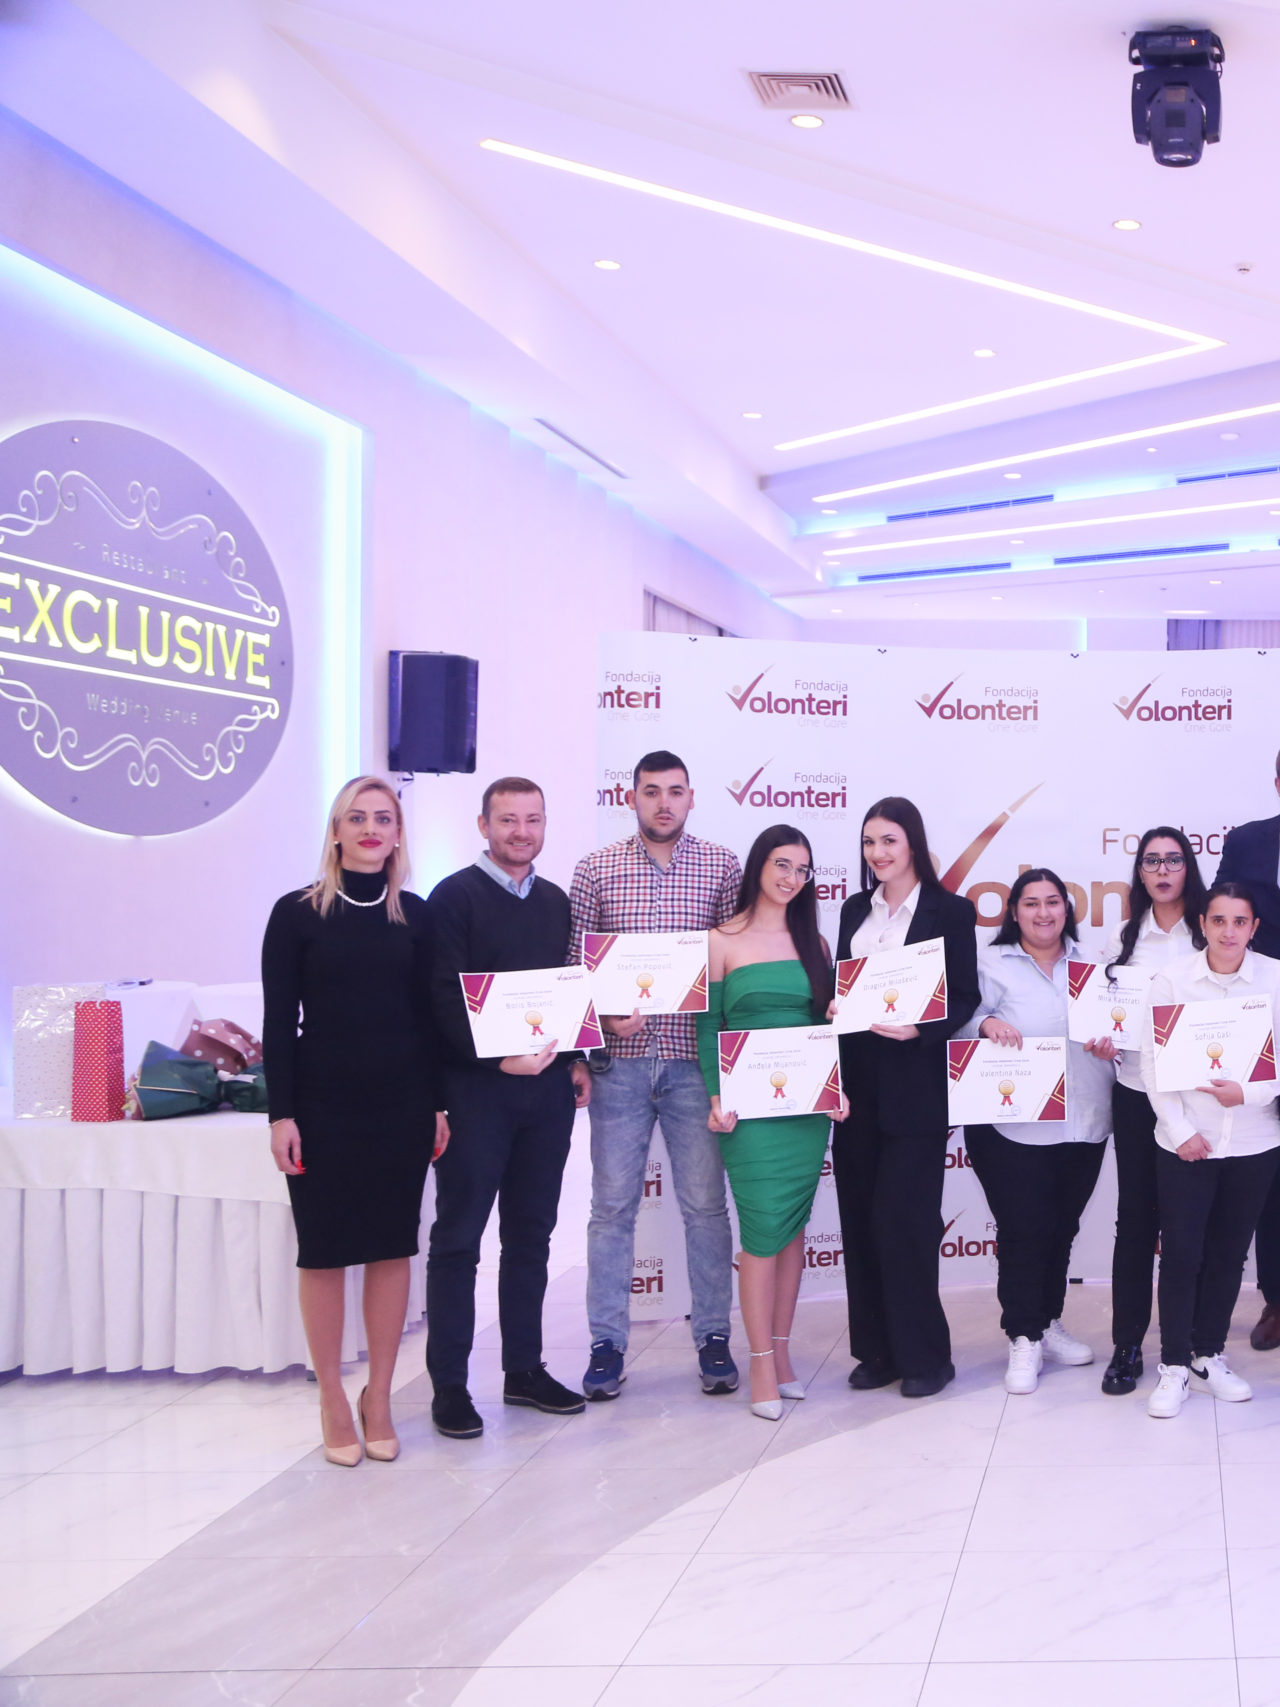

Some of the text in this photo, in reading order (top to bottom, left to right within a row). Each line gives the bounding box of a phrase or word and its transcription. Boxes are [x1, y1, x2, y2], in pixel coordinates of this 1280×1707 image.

[0, 571, 271, 689] EXCLUSIVE
[605, 670, 662, 685] Fondacija
[725, 666, 848, 717] Volonteri
[794, 679, 848, 694] Fondacija
[984, 686, 1039, 699] Fondacija
[1181, 686, 1233, 698] Fondacija
[914, 673, 1038, 721] Volonteri
[1112, 675, 1232, 722] Volonteri
[725, 760, 847, 808] Volonteri
[794, 772, 847, 786] Fondacija
